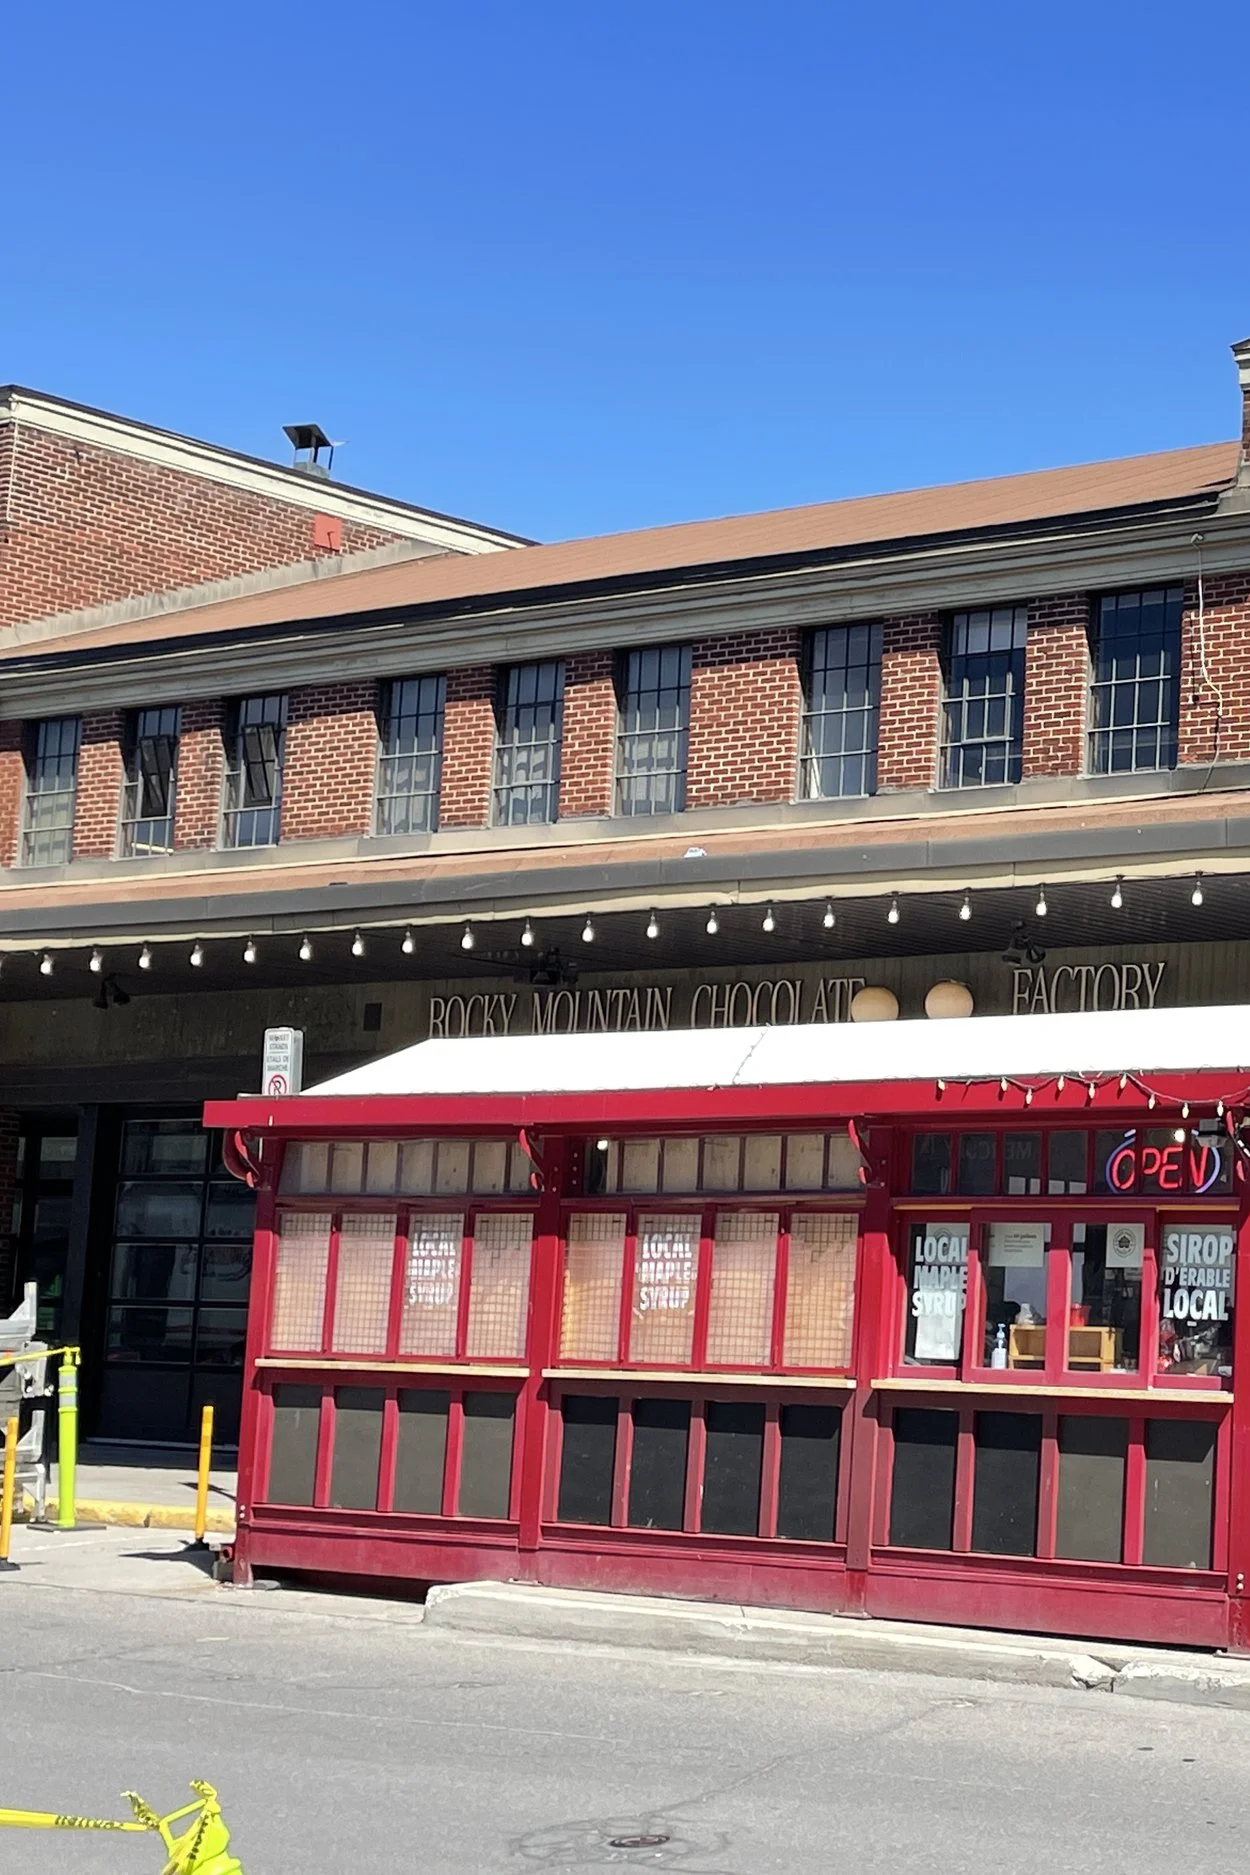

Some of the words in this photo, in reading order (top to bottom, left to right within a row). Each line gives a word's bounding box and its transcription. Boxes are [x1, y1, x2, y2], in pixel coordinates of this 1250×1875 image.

[1012, 962, 1166, 1014] FACTORY
[428, 994, 516, 1038] ROCKY
[530, 986, 673, 1034] MOUNTAIN
[1111, 1144, 1209, 1190] OPEN
[412, 1232, 456, 1257] LOCAL
[643, 1234, 692, 1259] LOCAL
[915, 1236, 968, 1262] LOCAL
[1166, 1233, 1233, 1265] SIROP
[641, 1262, 692, 1284] MAPLE
[913, 1265, 968, 1289] MAPLE
[640, 1286, 689, 1310] SYRUP
[911, 1291, 967, 1317] SYRUP
[1163, 1288, 1229, 1320] LOCAL
